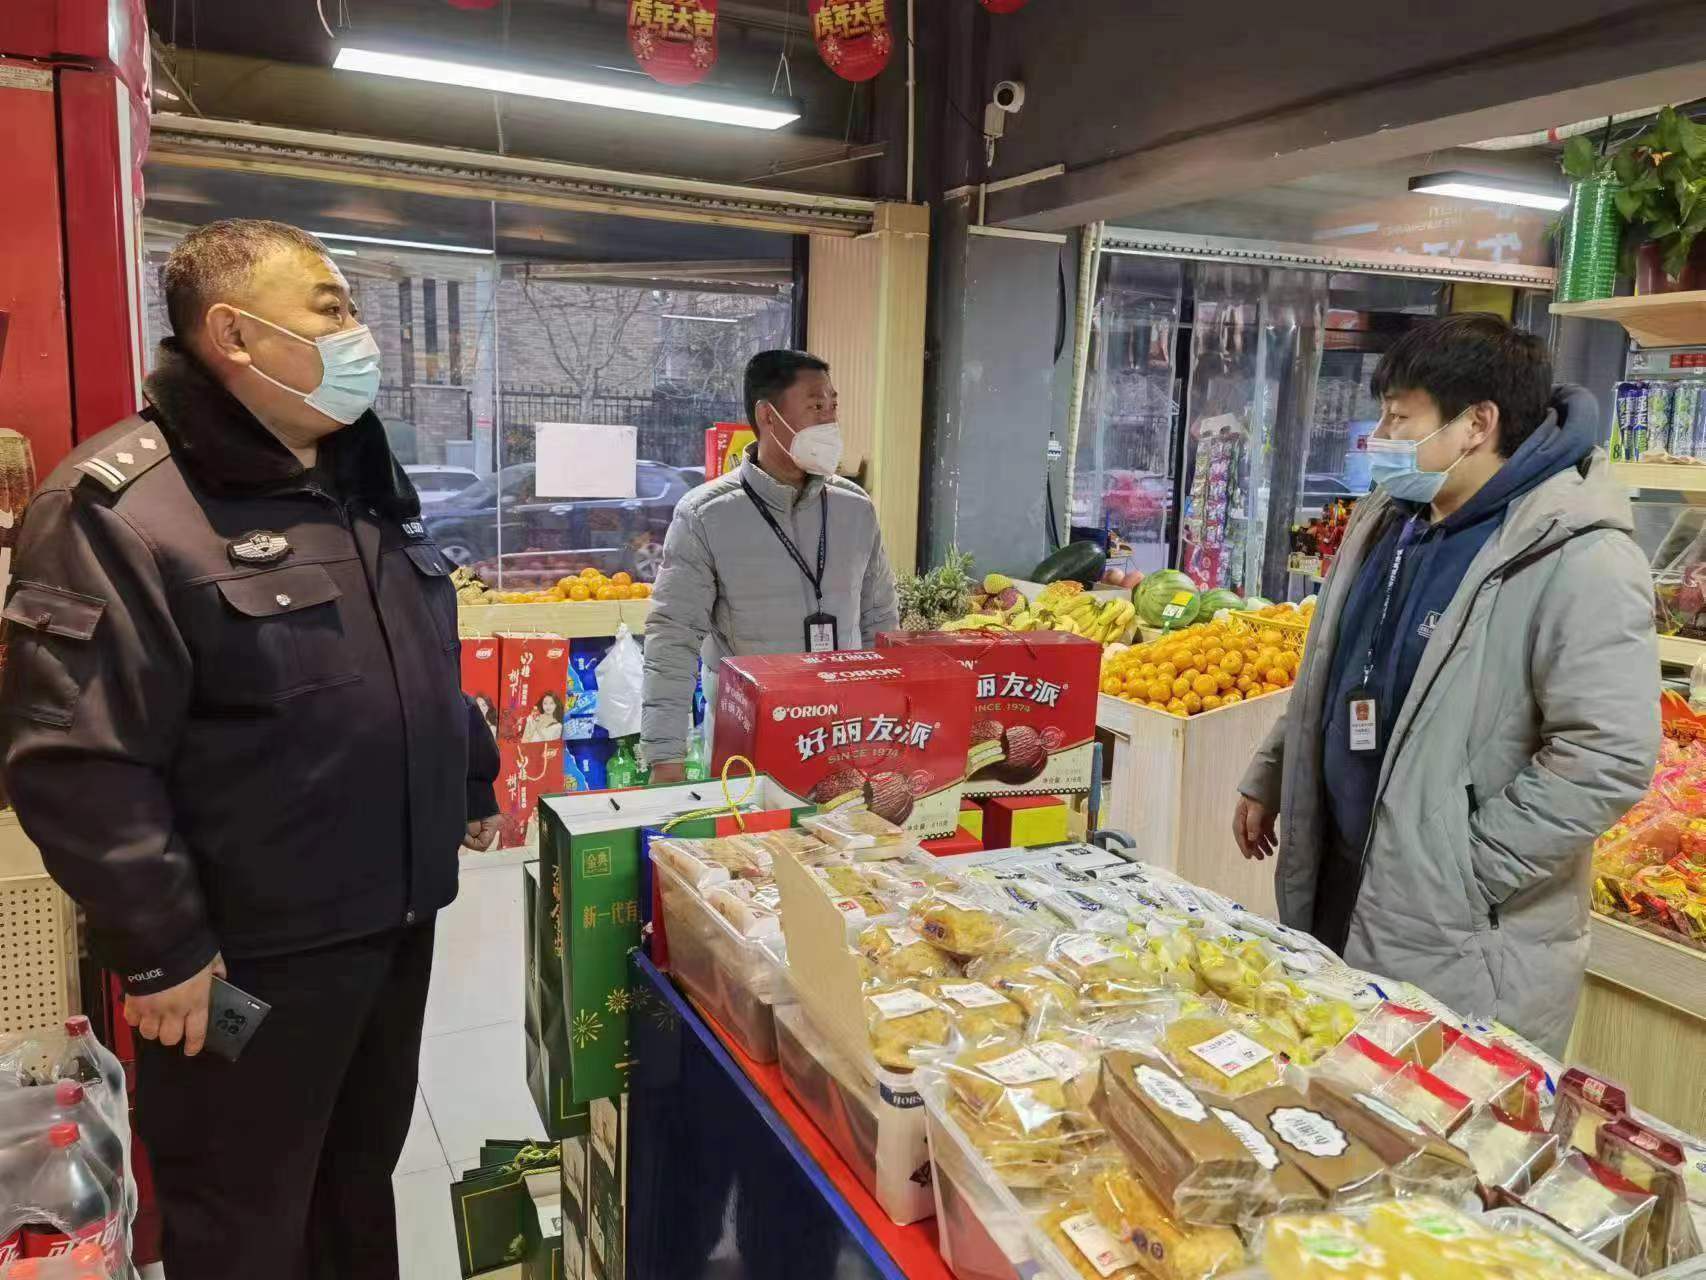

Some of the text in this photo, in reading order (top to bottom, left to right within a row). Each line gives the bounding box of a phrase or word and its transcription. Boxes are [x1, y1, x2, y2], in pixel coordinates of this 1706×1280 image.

[630, 0, 716, 37] 虎年大吉
[814, 0, 887, 38] 虎年大吉
[838, 668, 900, 679] ORION
[976, 671, 1062, 708] 丽友·派
[789, 703, 839, 719] ORION
[975, 702, 1031, 713] INCE 1974
[127, 967, 165, 983] POLICE
